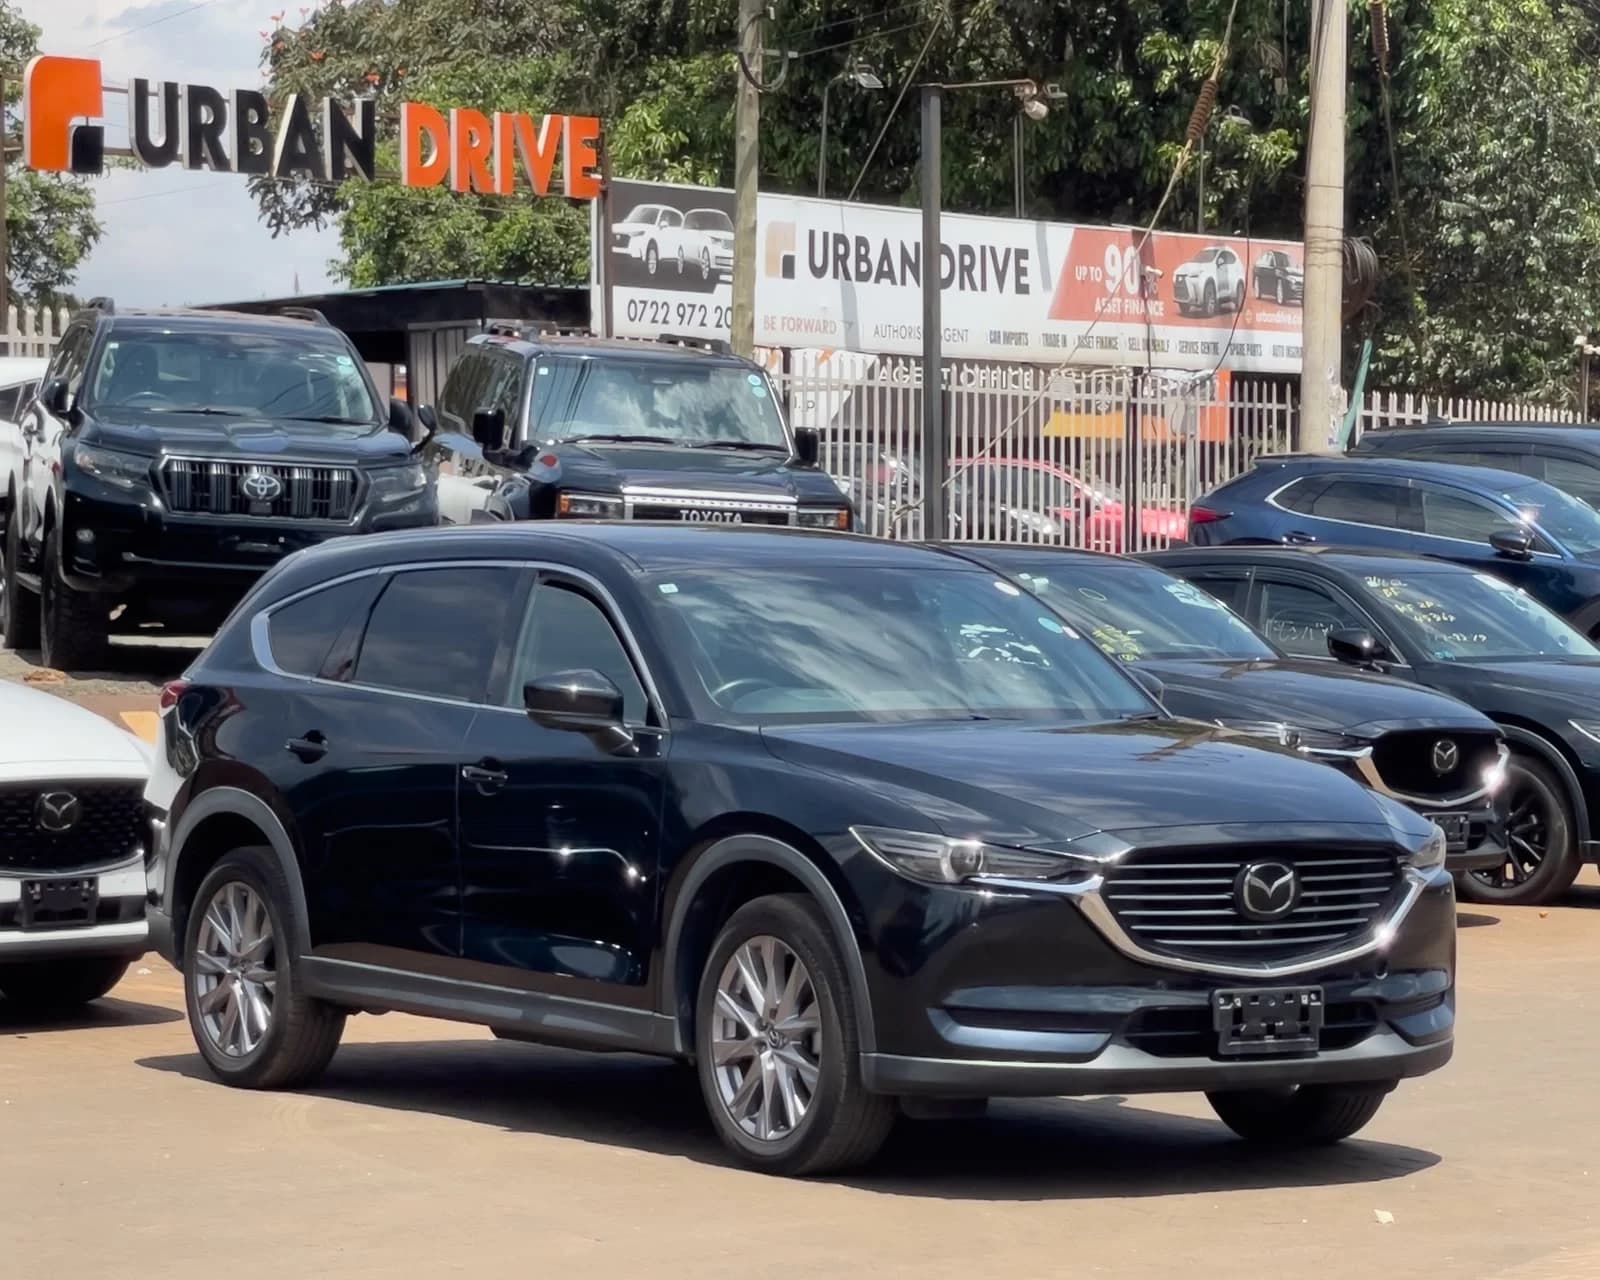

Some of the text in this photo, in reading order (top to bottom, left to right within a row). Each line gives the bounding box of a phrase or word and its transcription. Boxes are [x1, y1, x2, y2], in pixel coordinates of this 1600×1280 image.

[128, 78, 599, 198] URBAN DRIVE
[807, 228, 1030, 295] URBAN DRIVE
[1075, 265, 1088, 281] UP
[1089, 266, 1103, 282] TO
[627, 299, 733, 329] 0722 972 20
[1094, 297, 1164, 317] ASSET FINANCE
[763, 314, 838, 336] BE FORWARD
[873, 324, 969, 342] AUTHORIS GENT
[989, 329, 1029, 347] CAR IMPORTS
[1042, 333, 1060, 348] TRADE
[1095, 336, 1119, 350] FINANCE
[878, 366, 1034, 390] AGET OFFICE
[679, 509, 743, 523] TOYOTA
